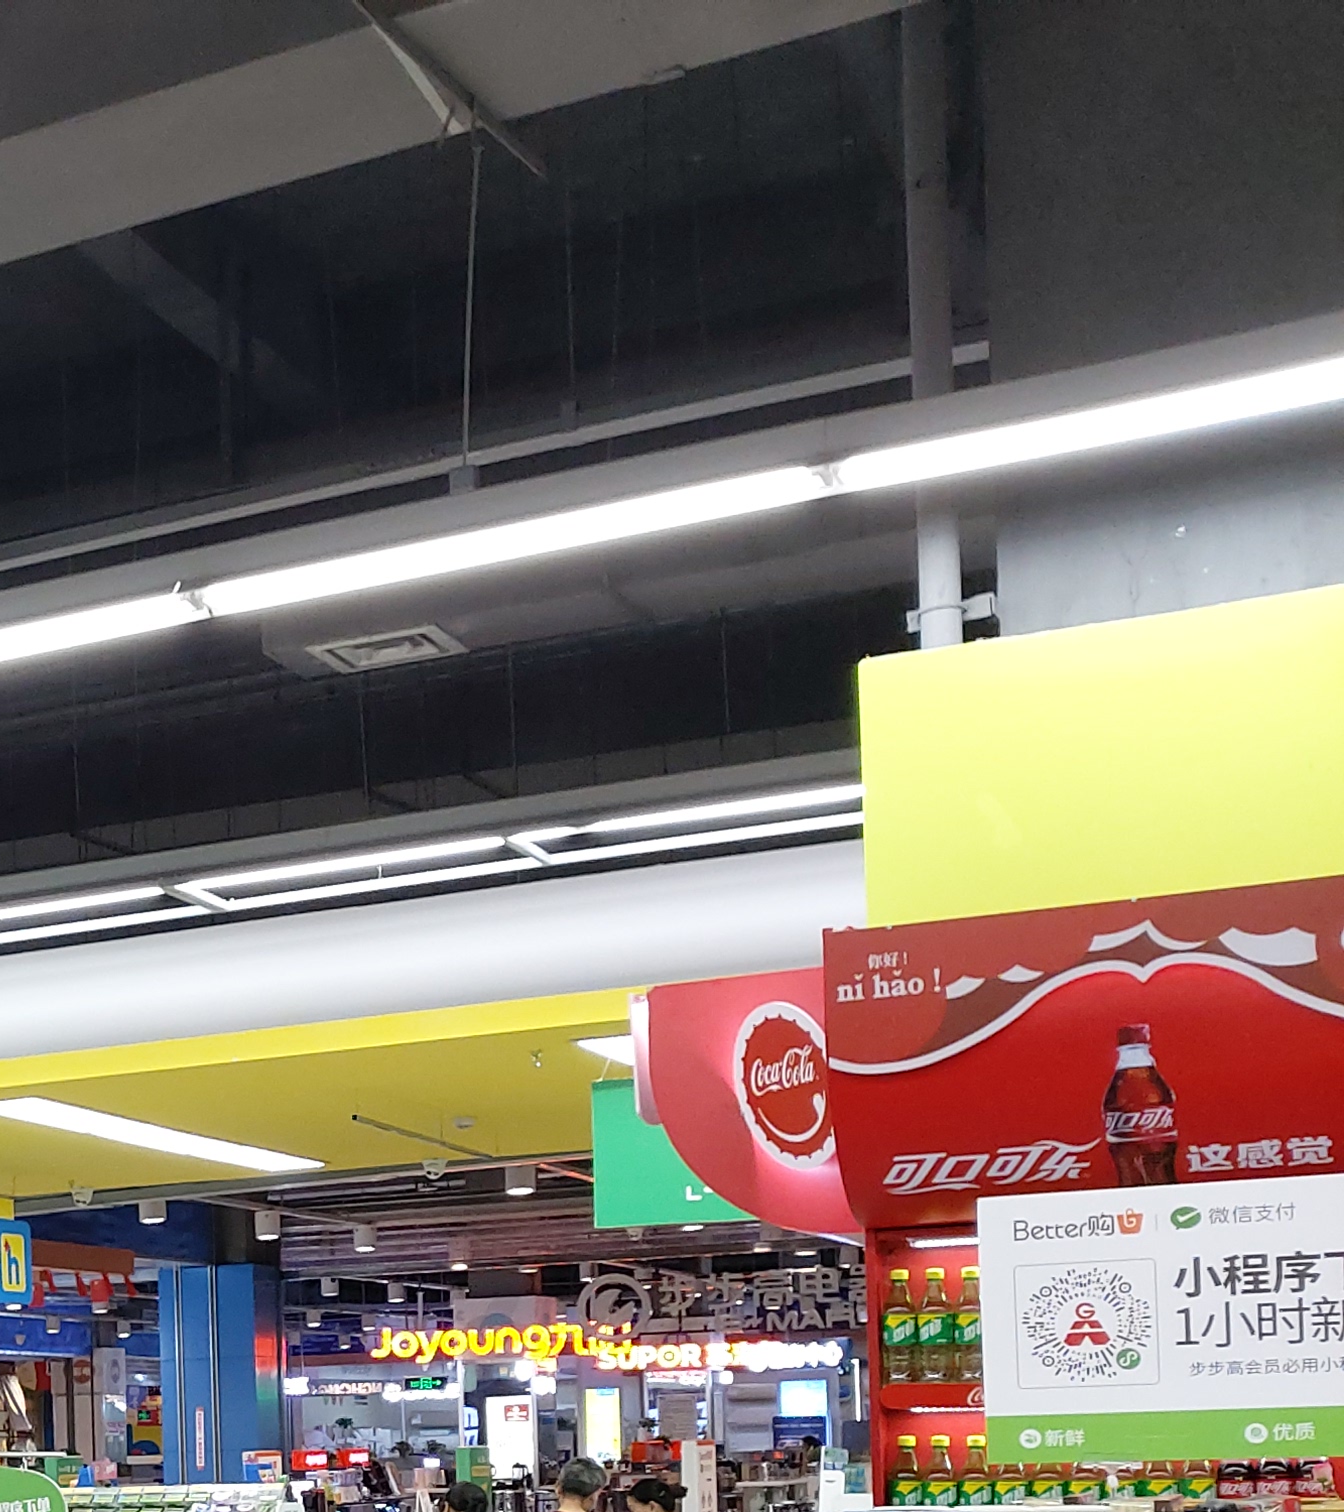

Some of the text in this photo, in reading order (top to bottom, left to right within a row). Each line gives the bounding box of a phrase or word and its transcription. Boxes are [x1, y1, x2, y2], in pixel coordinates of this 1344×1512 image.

[837, 974, 865, 1002] nǐ
[872, 969, 925, 999] hǎo
[883, 1138, 1102, 1195] 可口可乐
[1186, 1135, 1335, 1173] 这感觉
[1208, 1201, 1296, 1225] 微信支付
[598, 1343, 703, 1371] SUPOR
[1189, 1356, 1344, 1378] 步步高会员必用小
[1044, 1427, 1086, 1447] 新鲜
[1272, 1421, 1316, 1442] 优质
